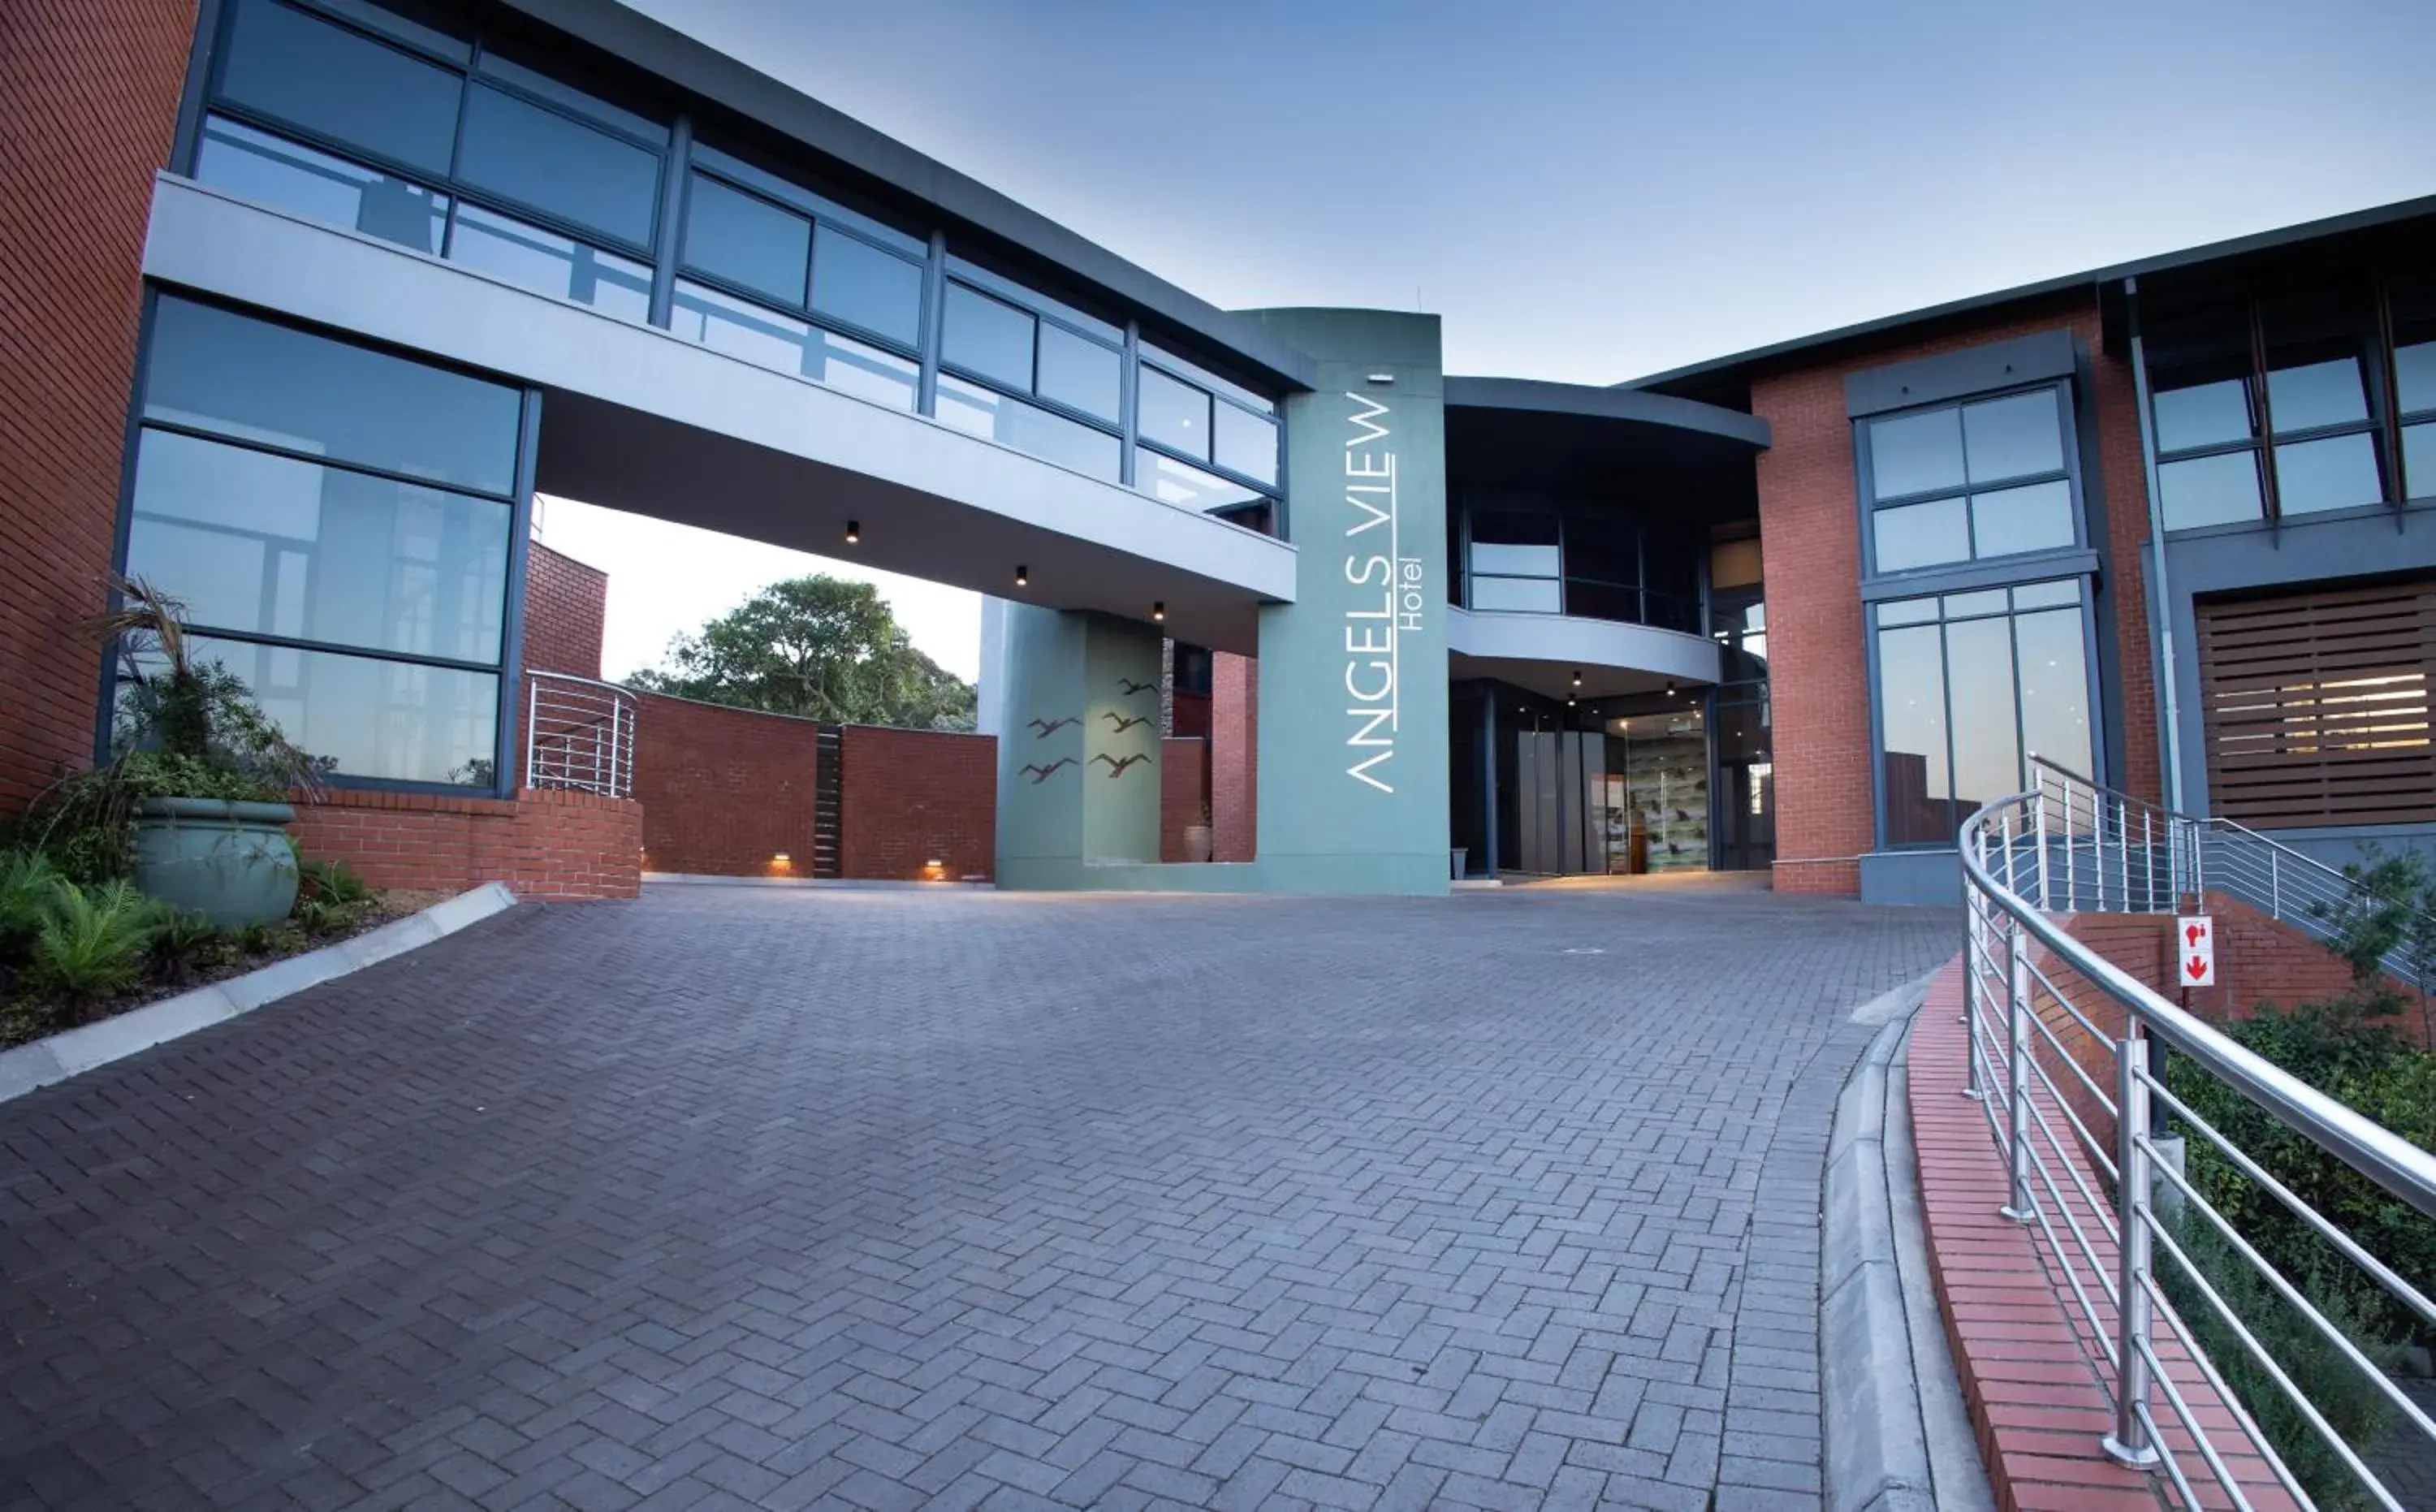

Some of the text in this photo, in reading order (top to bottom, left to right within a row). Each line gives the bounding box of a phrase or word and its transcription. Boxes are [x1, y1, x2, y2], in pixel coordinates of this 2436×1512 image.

[1345, 391, 1394, 794] ANGELS VIEW
[1398, 557, 1423, 632] Hotel
